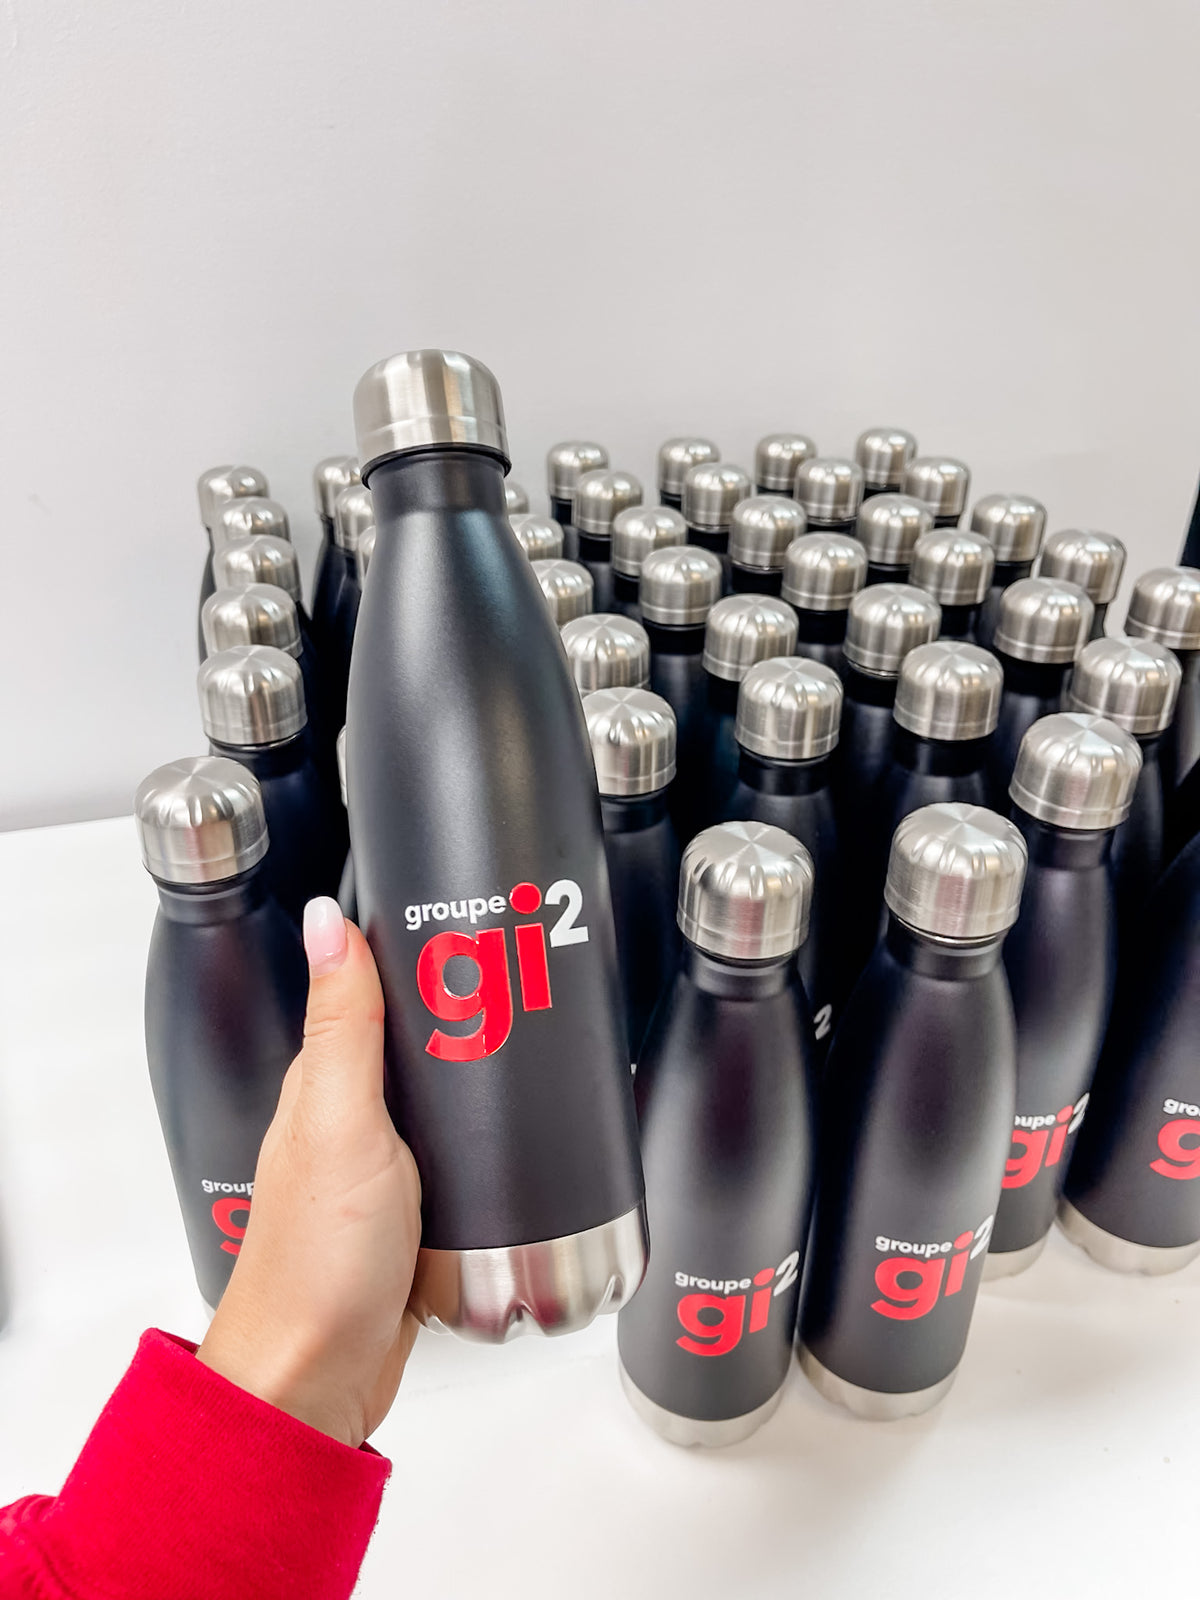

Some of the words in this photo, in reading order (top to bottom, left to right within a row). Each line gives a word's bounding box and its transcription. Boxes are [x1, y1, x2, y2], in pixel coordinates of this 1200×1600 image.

[404, 895, 507, 931] groupe
[1162, 1098, 1200, 1117] gro
[201, 1179, 255, 1196] group
[875, 1235, 953, 1259] groupe
[674, 1271, 752, 1295] groupe
